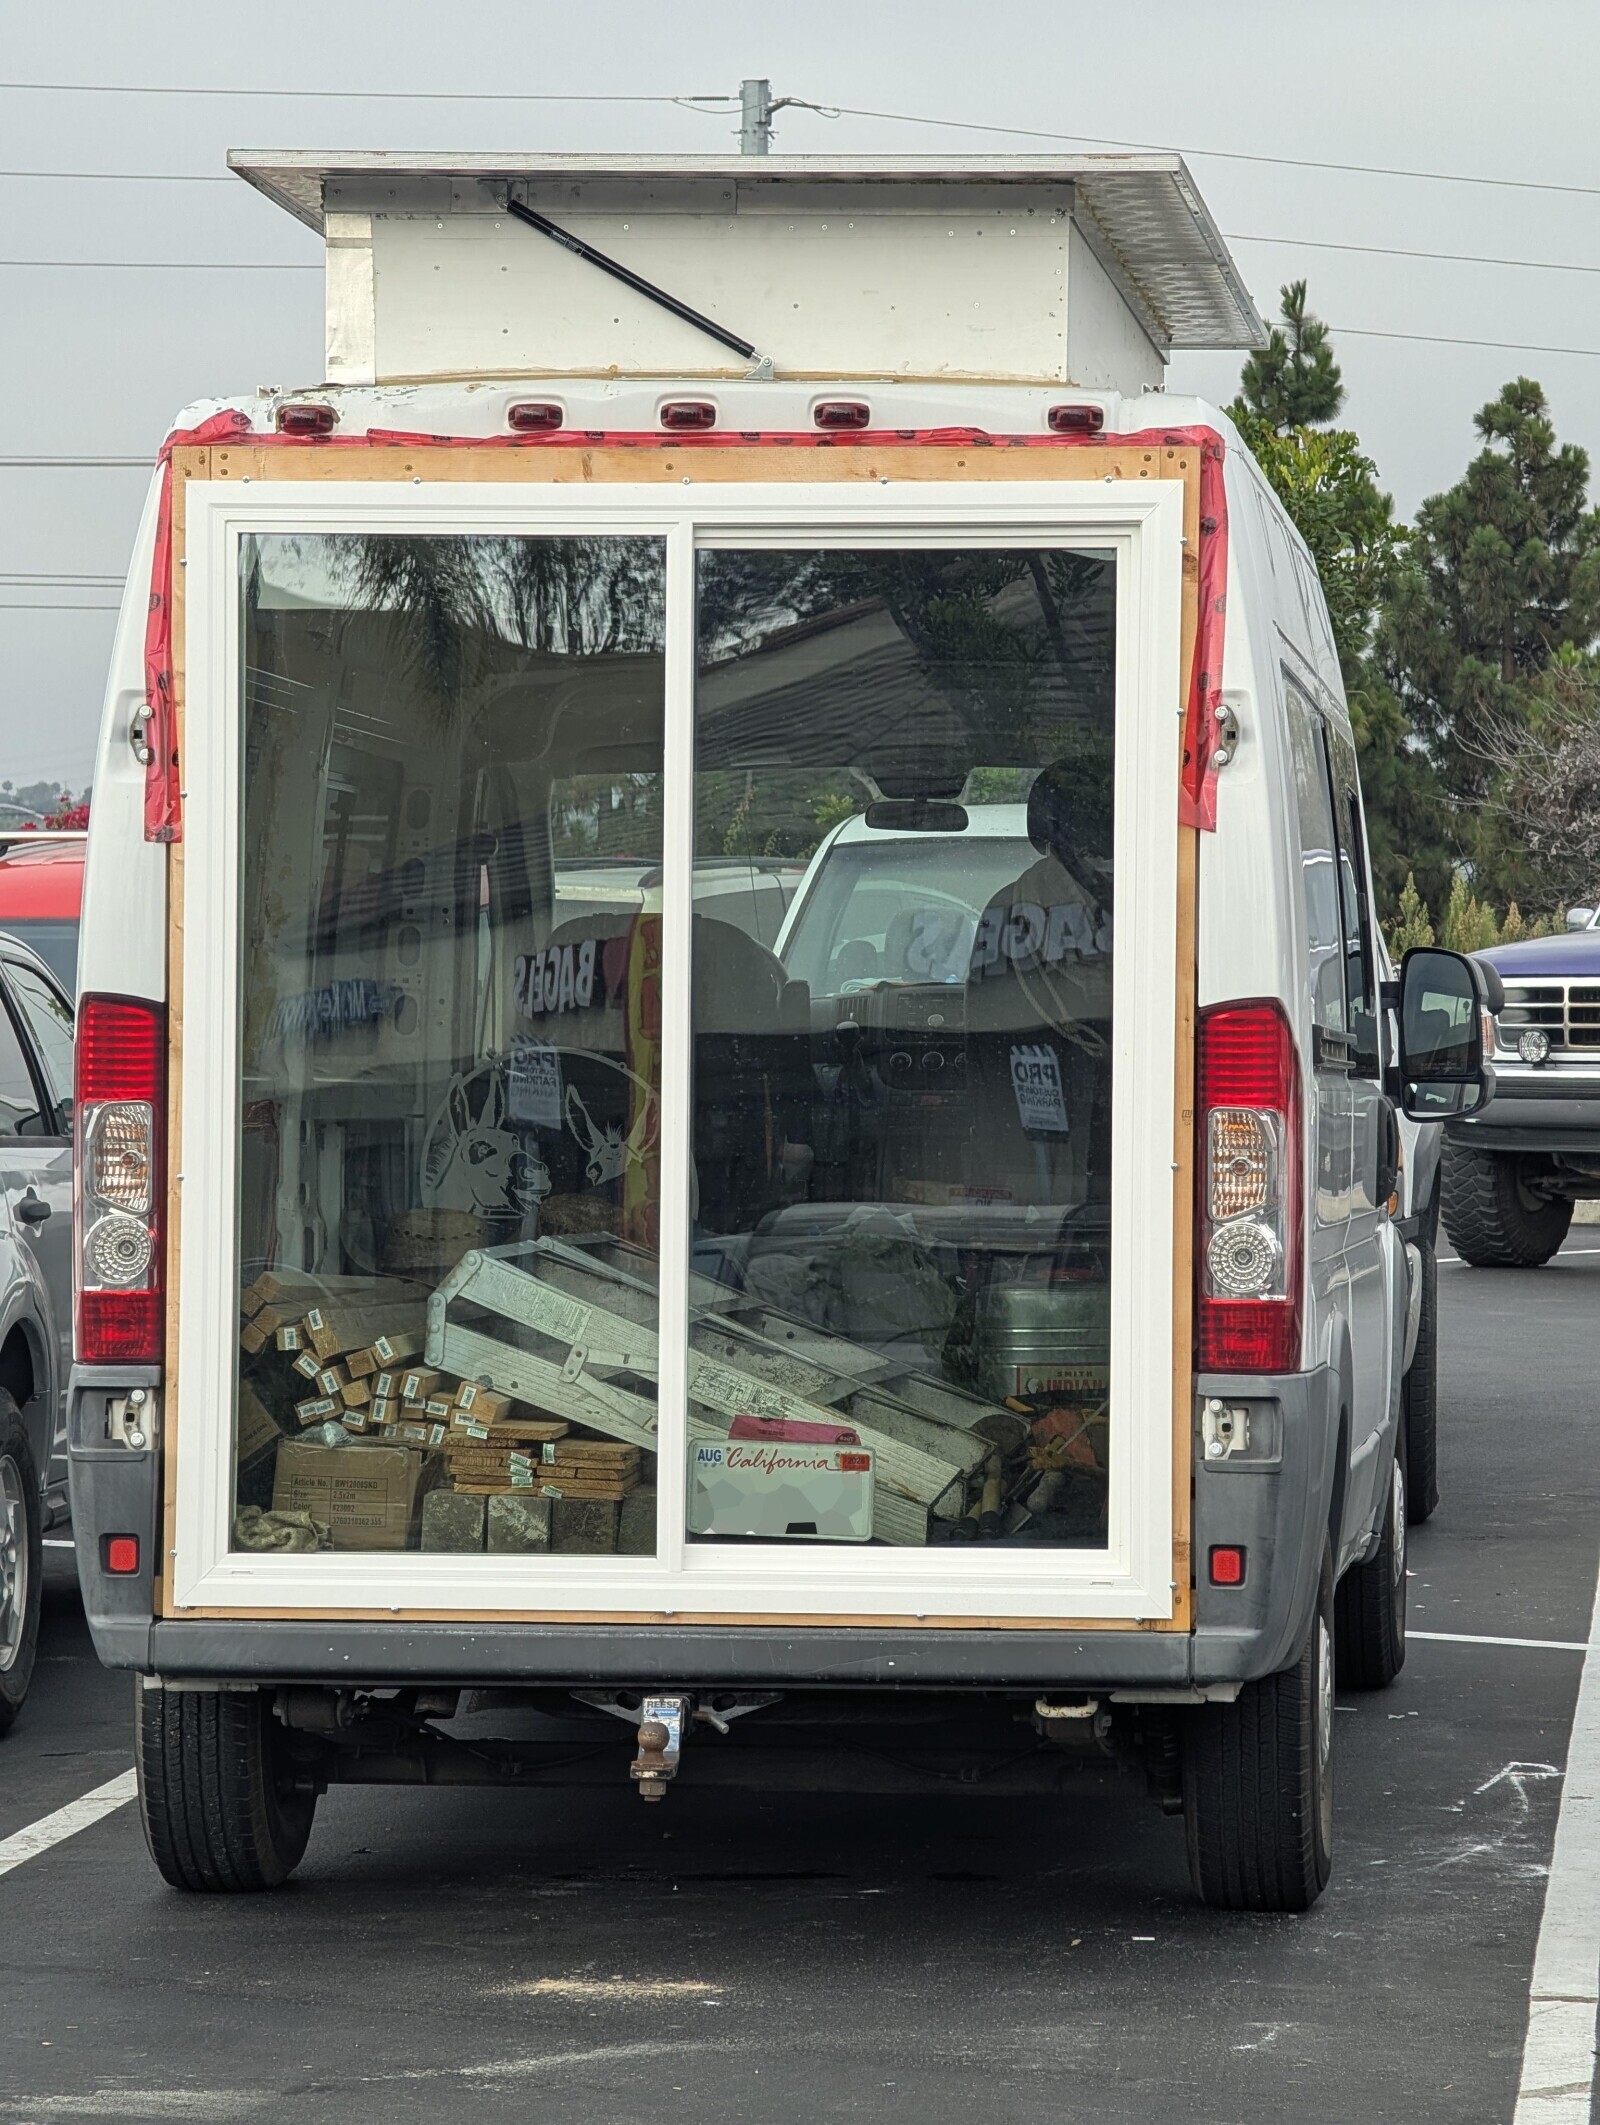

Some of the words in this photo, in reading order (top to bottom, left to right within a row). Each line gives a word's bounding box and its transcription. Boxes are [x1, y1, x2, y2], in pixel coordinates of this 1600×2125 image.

[698, 1449, 722, 1462] AUG
[727, 1447, 841, 1474] California
[294, 1477, 315, 1486] Article
[317, 1479, 328, 1487] No.
[293, 1501, 312, 1511] Color:
[647, 1700, 680, 1708] REESE
